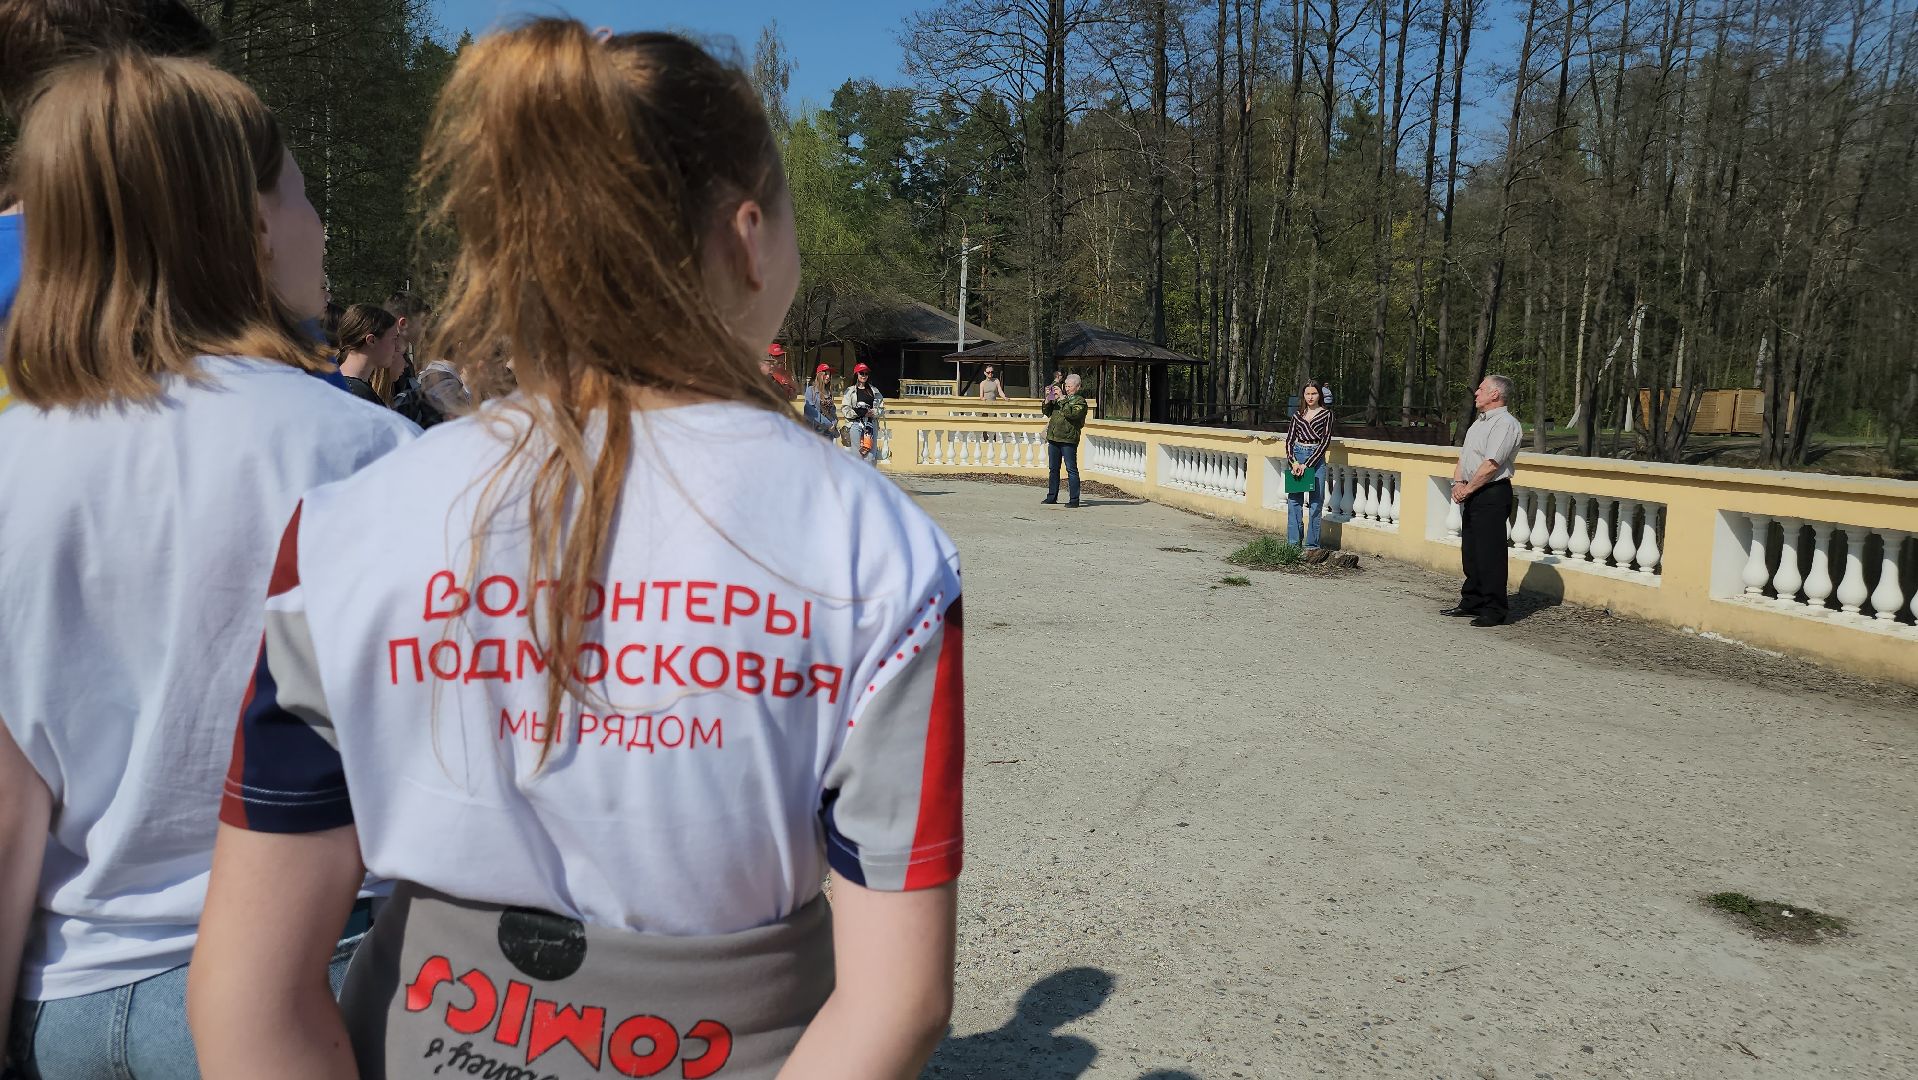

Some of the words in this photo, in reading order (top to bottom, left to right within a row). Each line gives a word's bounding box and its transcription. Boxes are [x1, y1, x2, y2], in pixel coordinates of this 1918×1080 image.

[388, 637, 843, 704] ПОДМОСКОВЬЯ
[499, 710, 563, 745] МЫ
[577, 714, 723, 753] РЯДОМ
[404, 955, 734, 1080] COMICS
